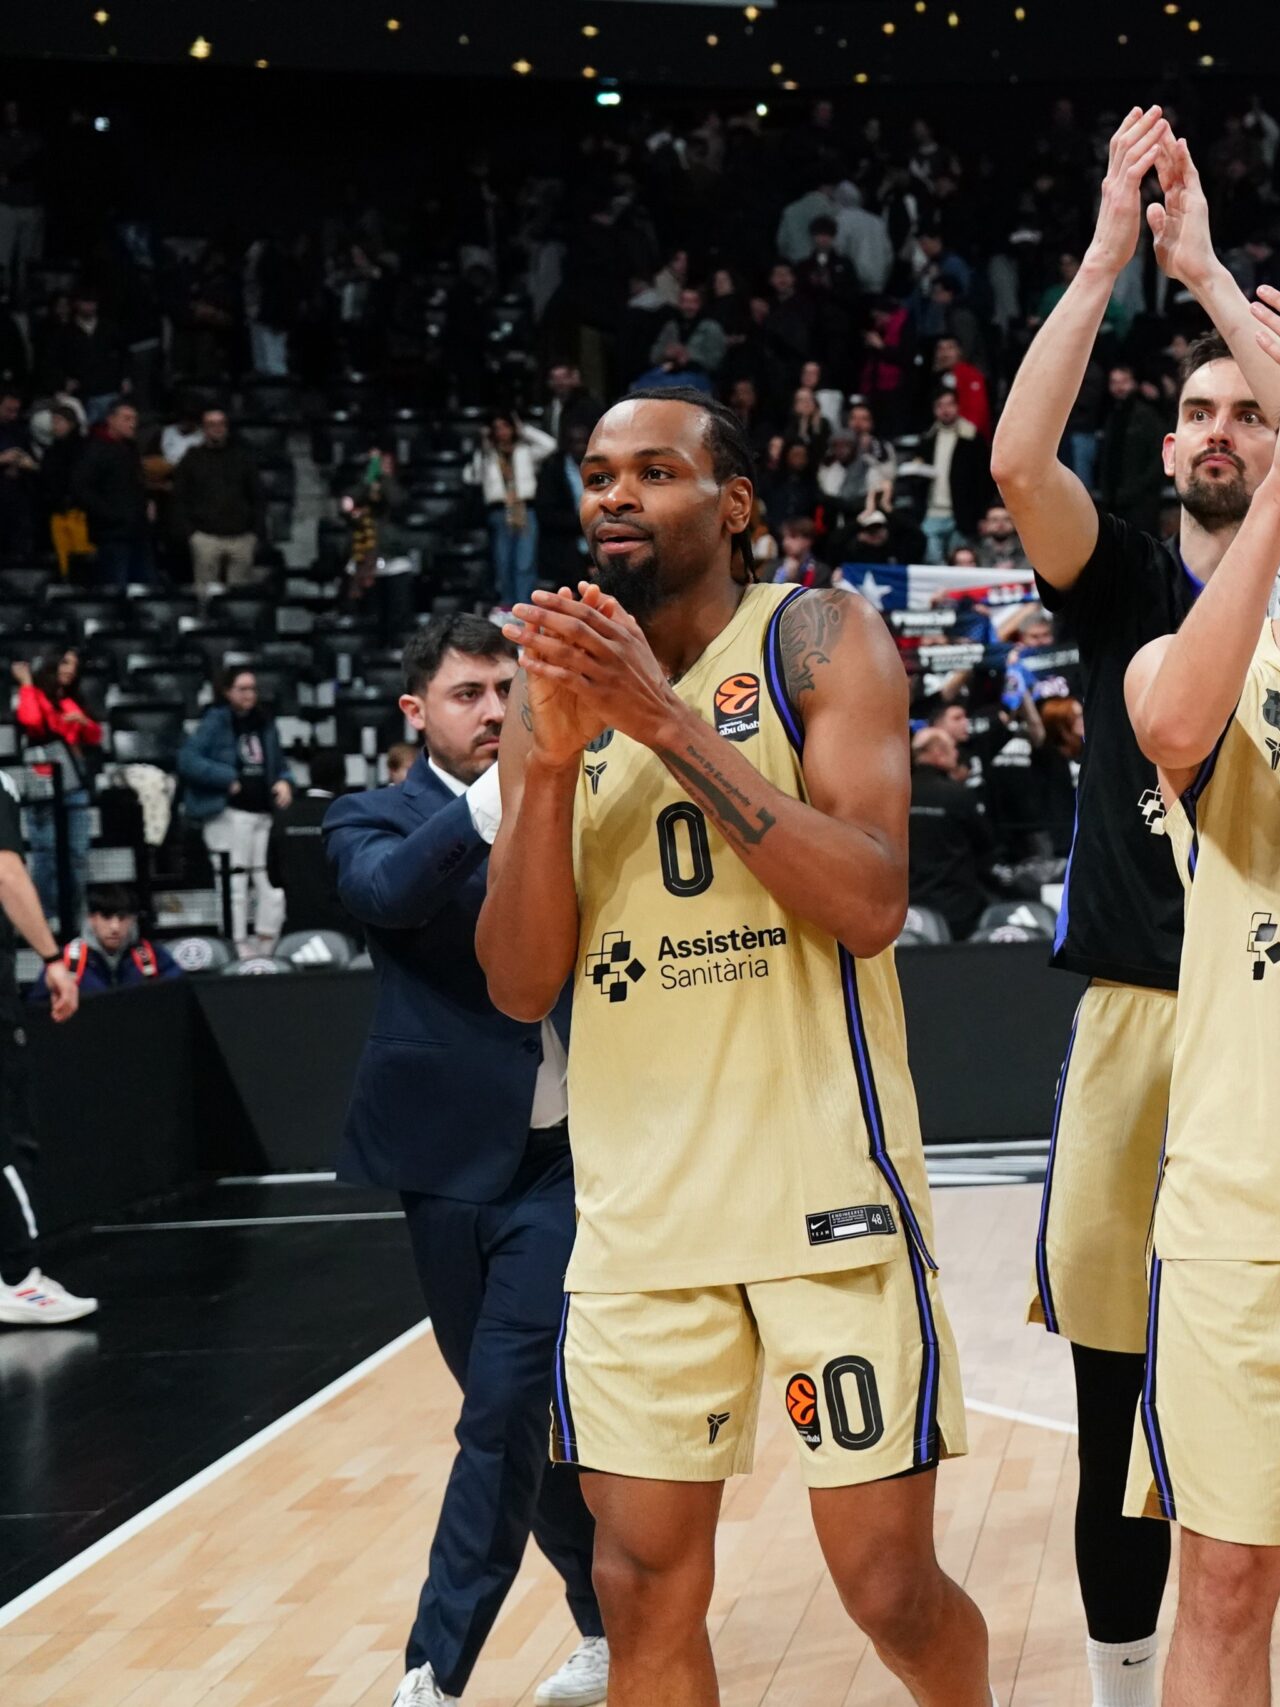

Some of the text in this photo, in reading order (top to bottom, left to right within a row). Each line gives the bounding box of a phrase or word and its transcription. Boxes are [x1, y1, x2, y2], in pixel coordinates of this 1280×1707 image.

[719, 720, 759, 736] abu dhab
[656, 801, 715, 898] 0
[660, 954, 769, 990] Sanitària
[871, 1213, 883, 1225] 48
[822, 1354, 885, 1451] 0
